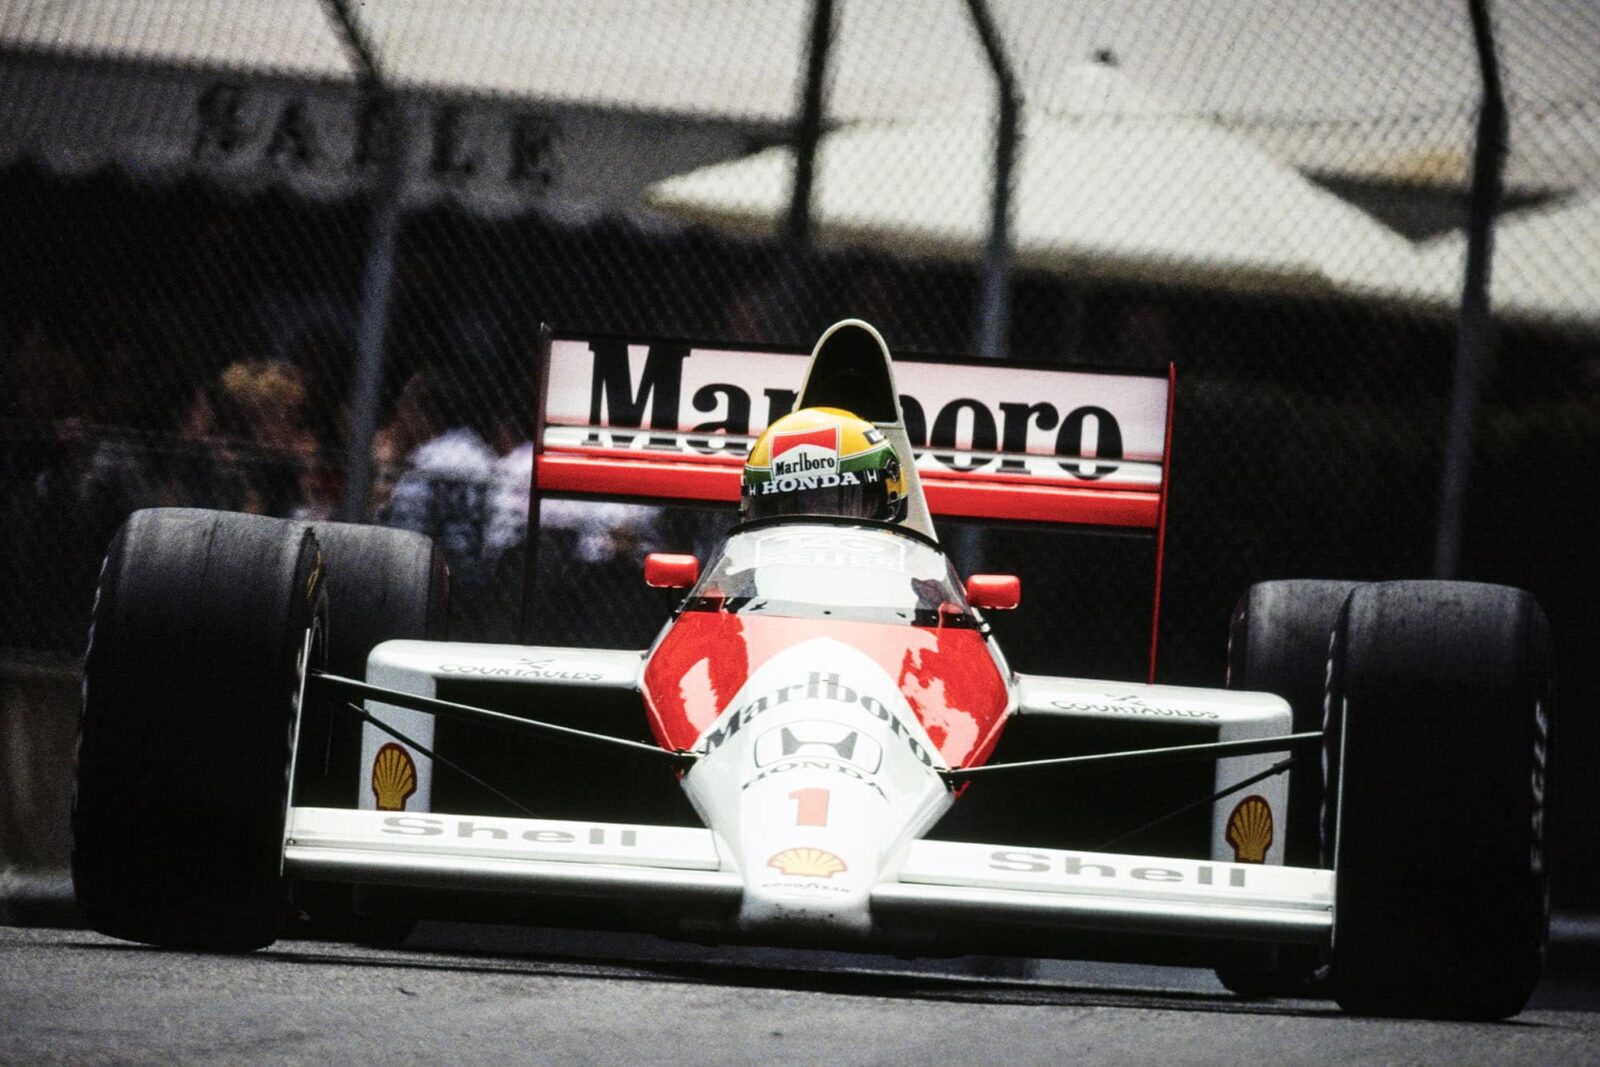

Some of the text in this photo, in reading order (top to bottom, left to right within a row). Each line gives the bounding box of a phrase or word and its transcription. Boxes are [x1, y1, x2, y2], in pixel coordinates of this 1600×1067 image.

[581, 342, 1123, 480] Maoro
[775, 452, 835, 476] Marlboro
[762, 471, 860, 495] HONDA
[438, 664, 604, 681] COURTAULDS
[704, 671, 932, 767] Marlboro
[1050, 700, 1220, 719] COURTAULDS
[739, 761, 890, 804] HONDA
[788, 787, 830, 827] 1
[380, 815, 637, 847] Shell
[988, 850, 1246, 888] Shell
